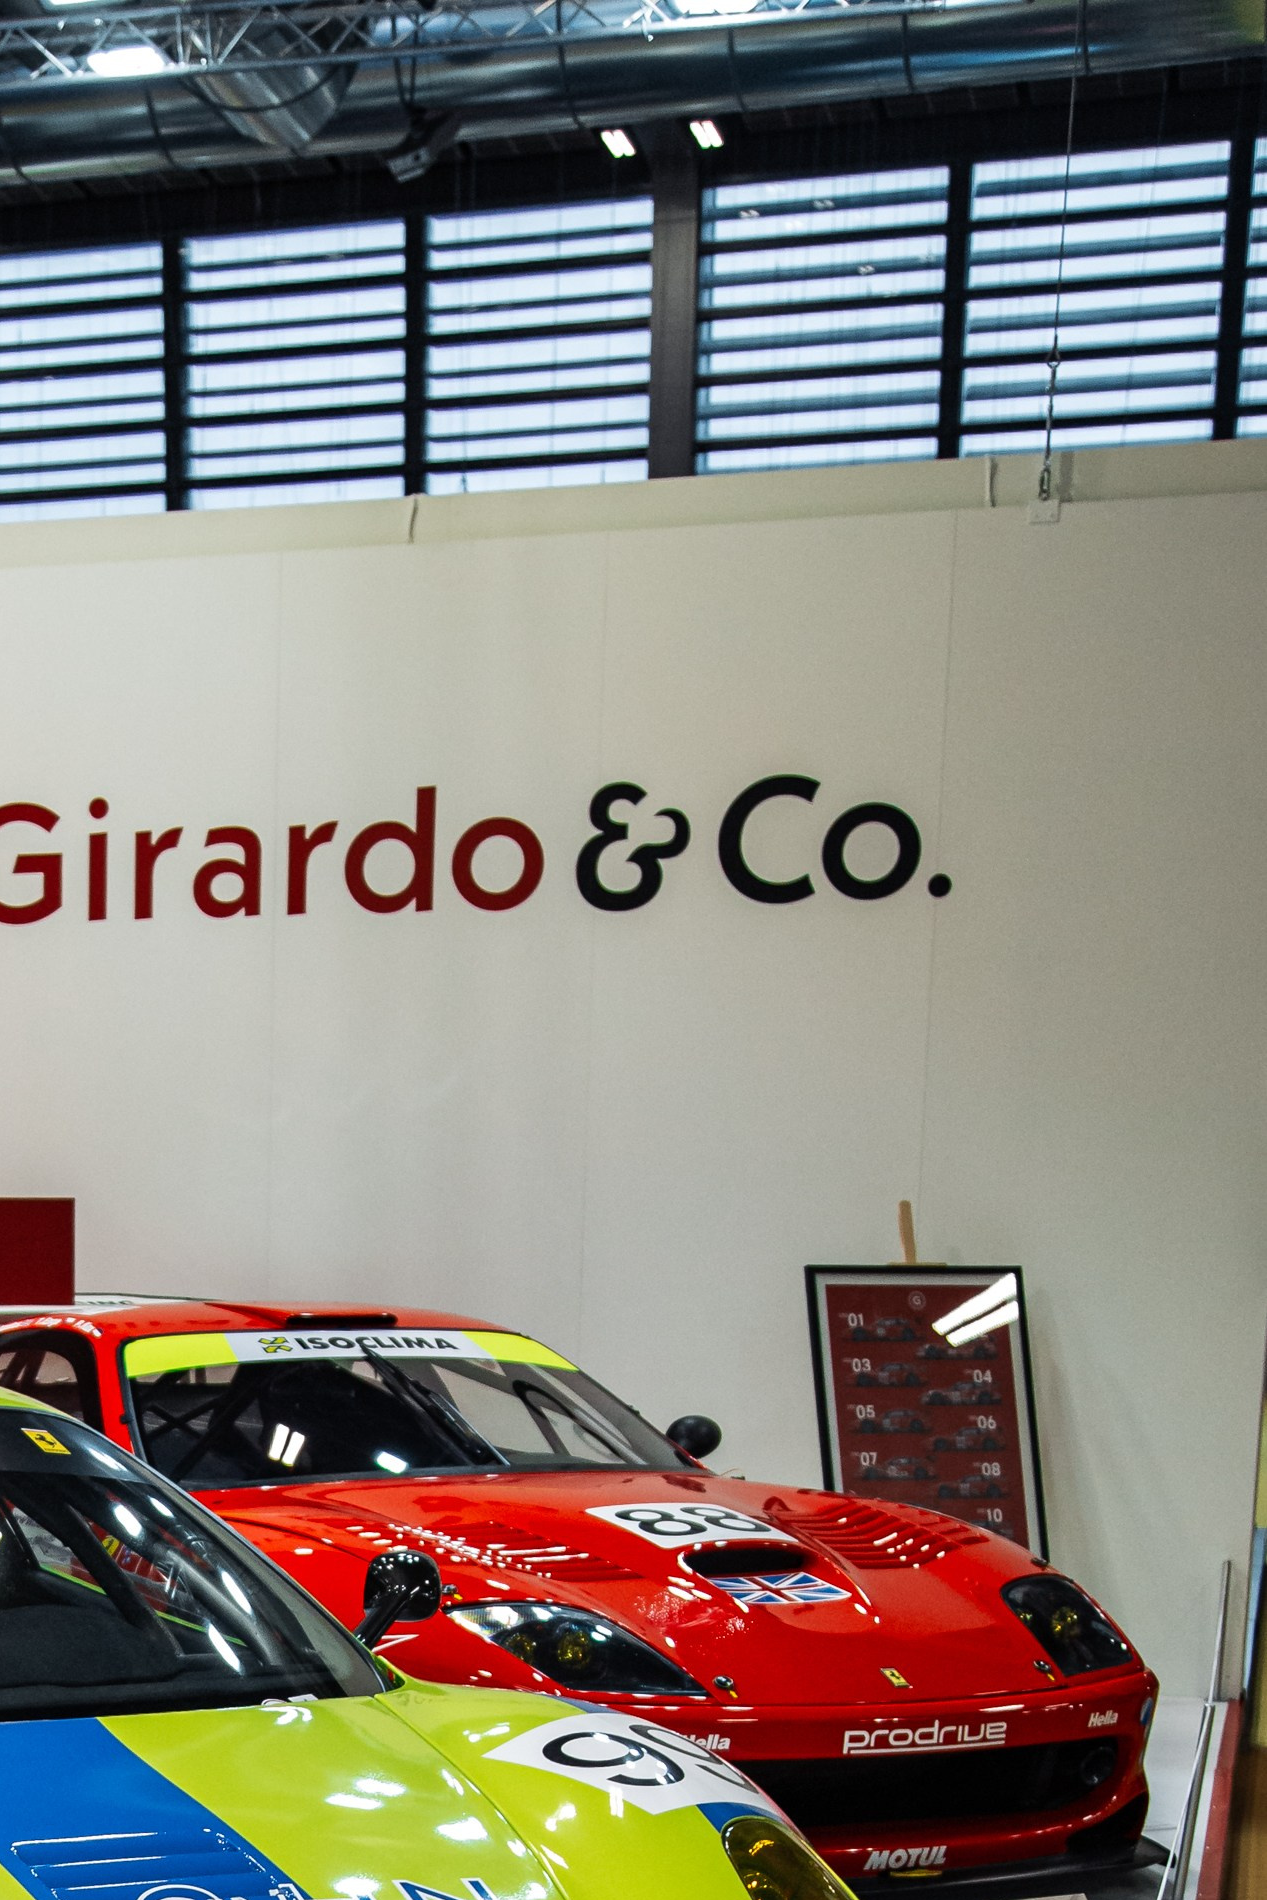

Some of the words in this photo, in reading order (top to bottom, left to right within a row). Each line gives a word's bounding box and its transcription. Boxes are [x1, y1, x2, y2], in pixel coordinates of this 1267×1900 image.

[575, 780, 691, 912] &
[717, 773, 953, 904] Co.
[847, 1313, 863, 1327] 01
[294, 1335, 461, 1350] ISOCLIMA
[852, 1359, 871, 1372] 03
[973, 1369, 992, 1383] 04
[856, 1405, 875, 1418] 05
[977, 1416, 996, 1429] 06
[860, 1452, 877, 1466] 07
[982, 1463, 1001, 1476] 08
[615, 1506, 772, 1536] 88
[987, 1509, 1003, 1522] 10
[1087, 1710, 1118, 1728] Hella
[842, 1719, 1007, 1755] prodrive
[863, 1845, 948, 1871] MOTUL
